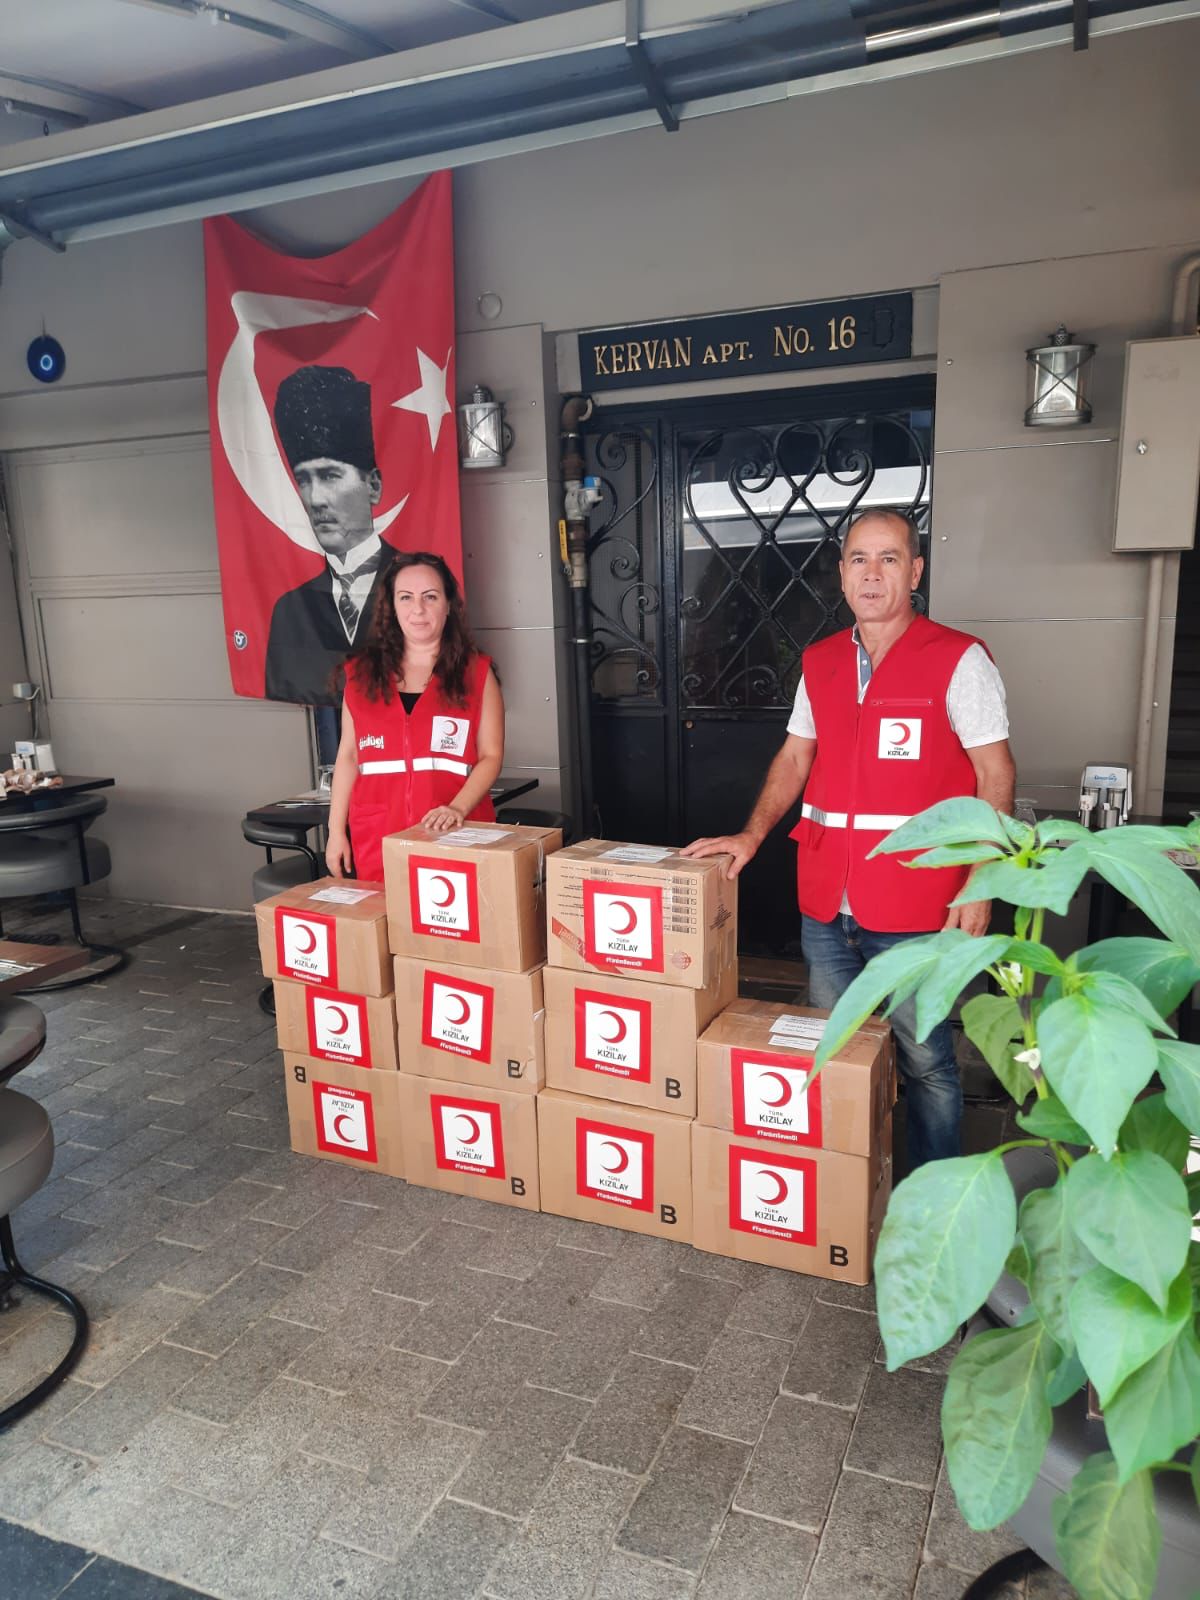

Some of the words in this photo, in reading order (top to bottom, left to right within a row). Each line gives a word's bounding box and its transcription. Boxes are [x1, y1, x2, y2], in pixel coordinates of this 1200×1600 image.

[594, 337, 692, 375] KERVAN
[702, 342, 753, 364] APT.
[828, 315, 856, 351] 16
[608, 943, 638, 953] KIZILAY
[443, 1030, 469, 1042] KIZILAY
[598, 1049, 627, 1062] KIZILAY
[294, 1066, 306, 1083] B
[508, 1060, 522, 1079] B
[666, 1078, 681, 1099] B
[760, 1115, 793, 1126] KIZILAY
[511, 1177, 526, 1196] B
[600, 1178, 629, 1191] KIZILAY
[661, 1205, 677, 1224] B
[755, 1211, 788, 1224] KIZILAY
[830, 1245, 848, 1267] B
